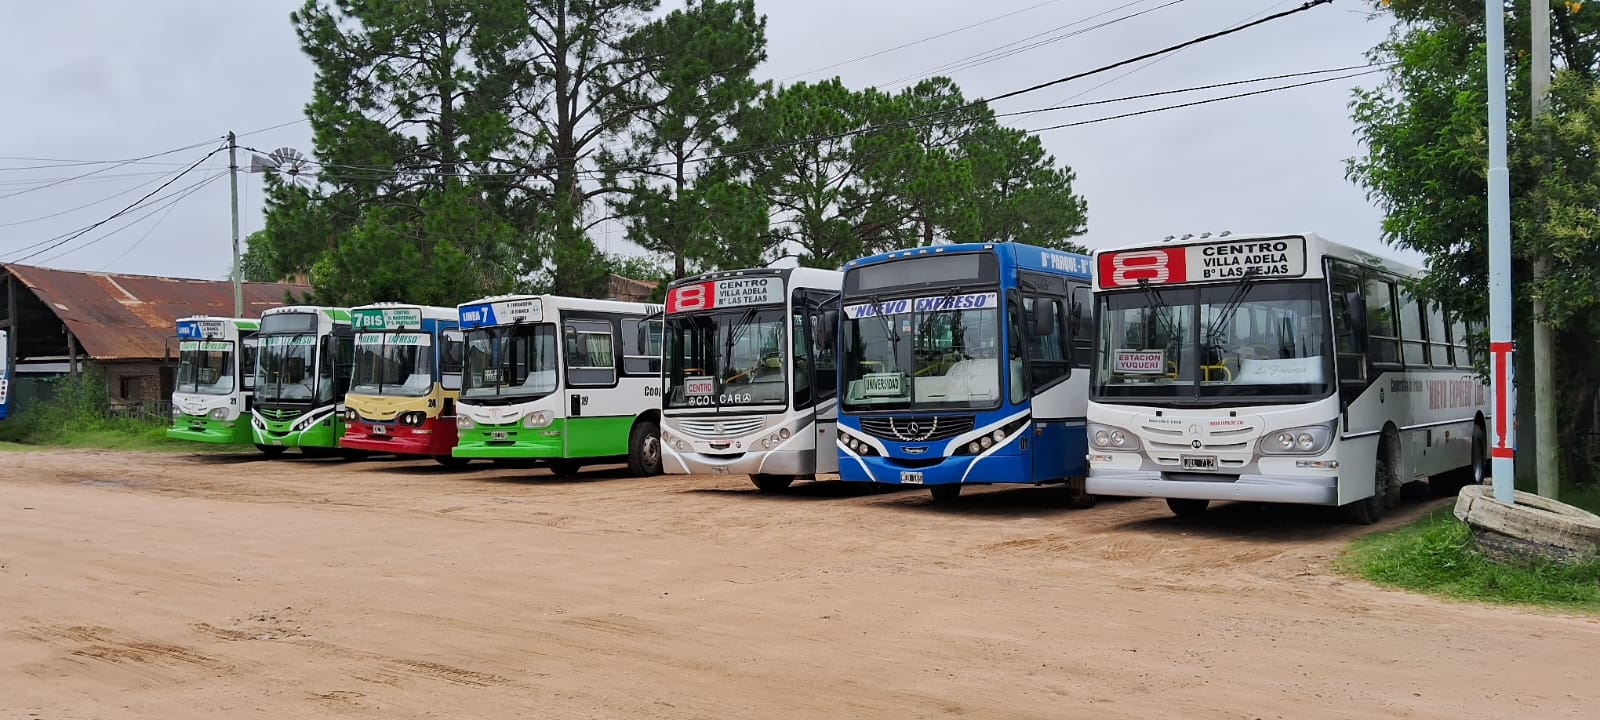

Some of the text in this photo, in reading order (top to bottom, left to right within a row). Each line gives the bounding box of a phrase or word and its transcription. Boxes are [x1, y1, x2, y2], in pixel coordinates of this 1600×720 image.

[1202, 241, 1288, 256] CENTRO
[1203, 253, 1288, 267] VILLA ADELA
[1112, 250, 1170, 286] 8
[1219, 268, 1243, 277] LAS
[1246, 264, 1289, 275] TEJAS
[719, 279, 768, 289] CENTRO
[742, 287, 768, 295] ADELA
[675, 284, 706, 313] 8
[744, 295, 768, 303] TEJAS
[354, 313, 382, 327] 7 BIS
[463, 307, 488, 322] LINEA 7
[191, 323, 197, 336] 7
[689, 383, 712, 392] CENTRO
[866, 378, 899, 390] UNIVERSIDAD
[230, 397, 236, 405] 21
[428, 399, 436, 408] 24
[582, 396, 588, 405] 19
